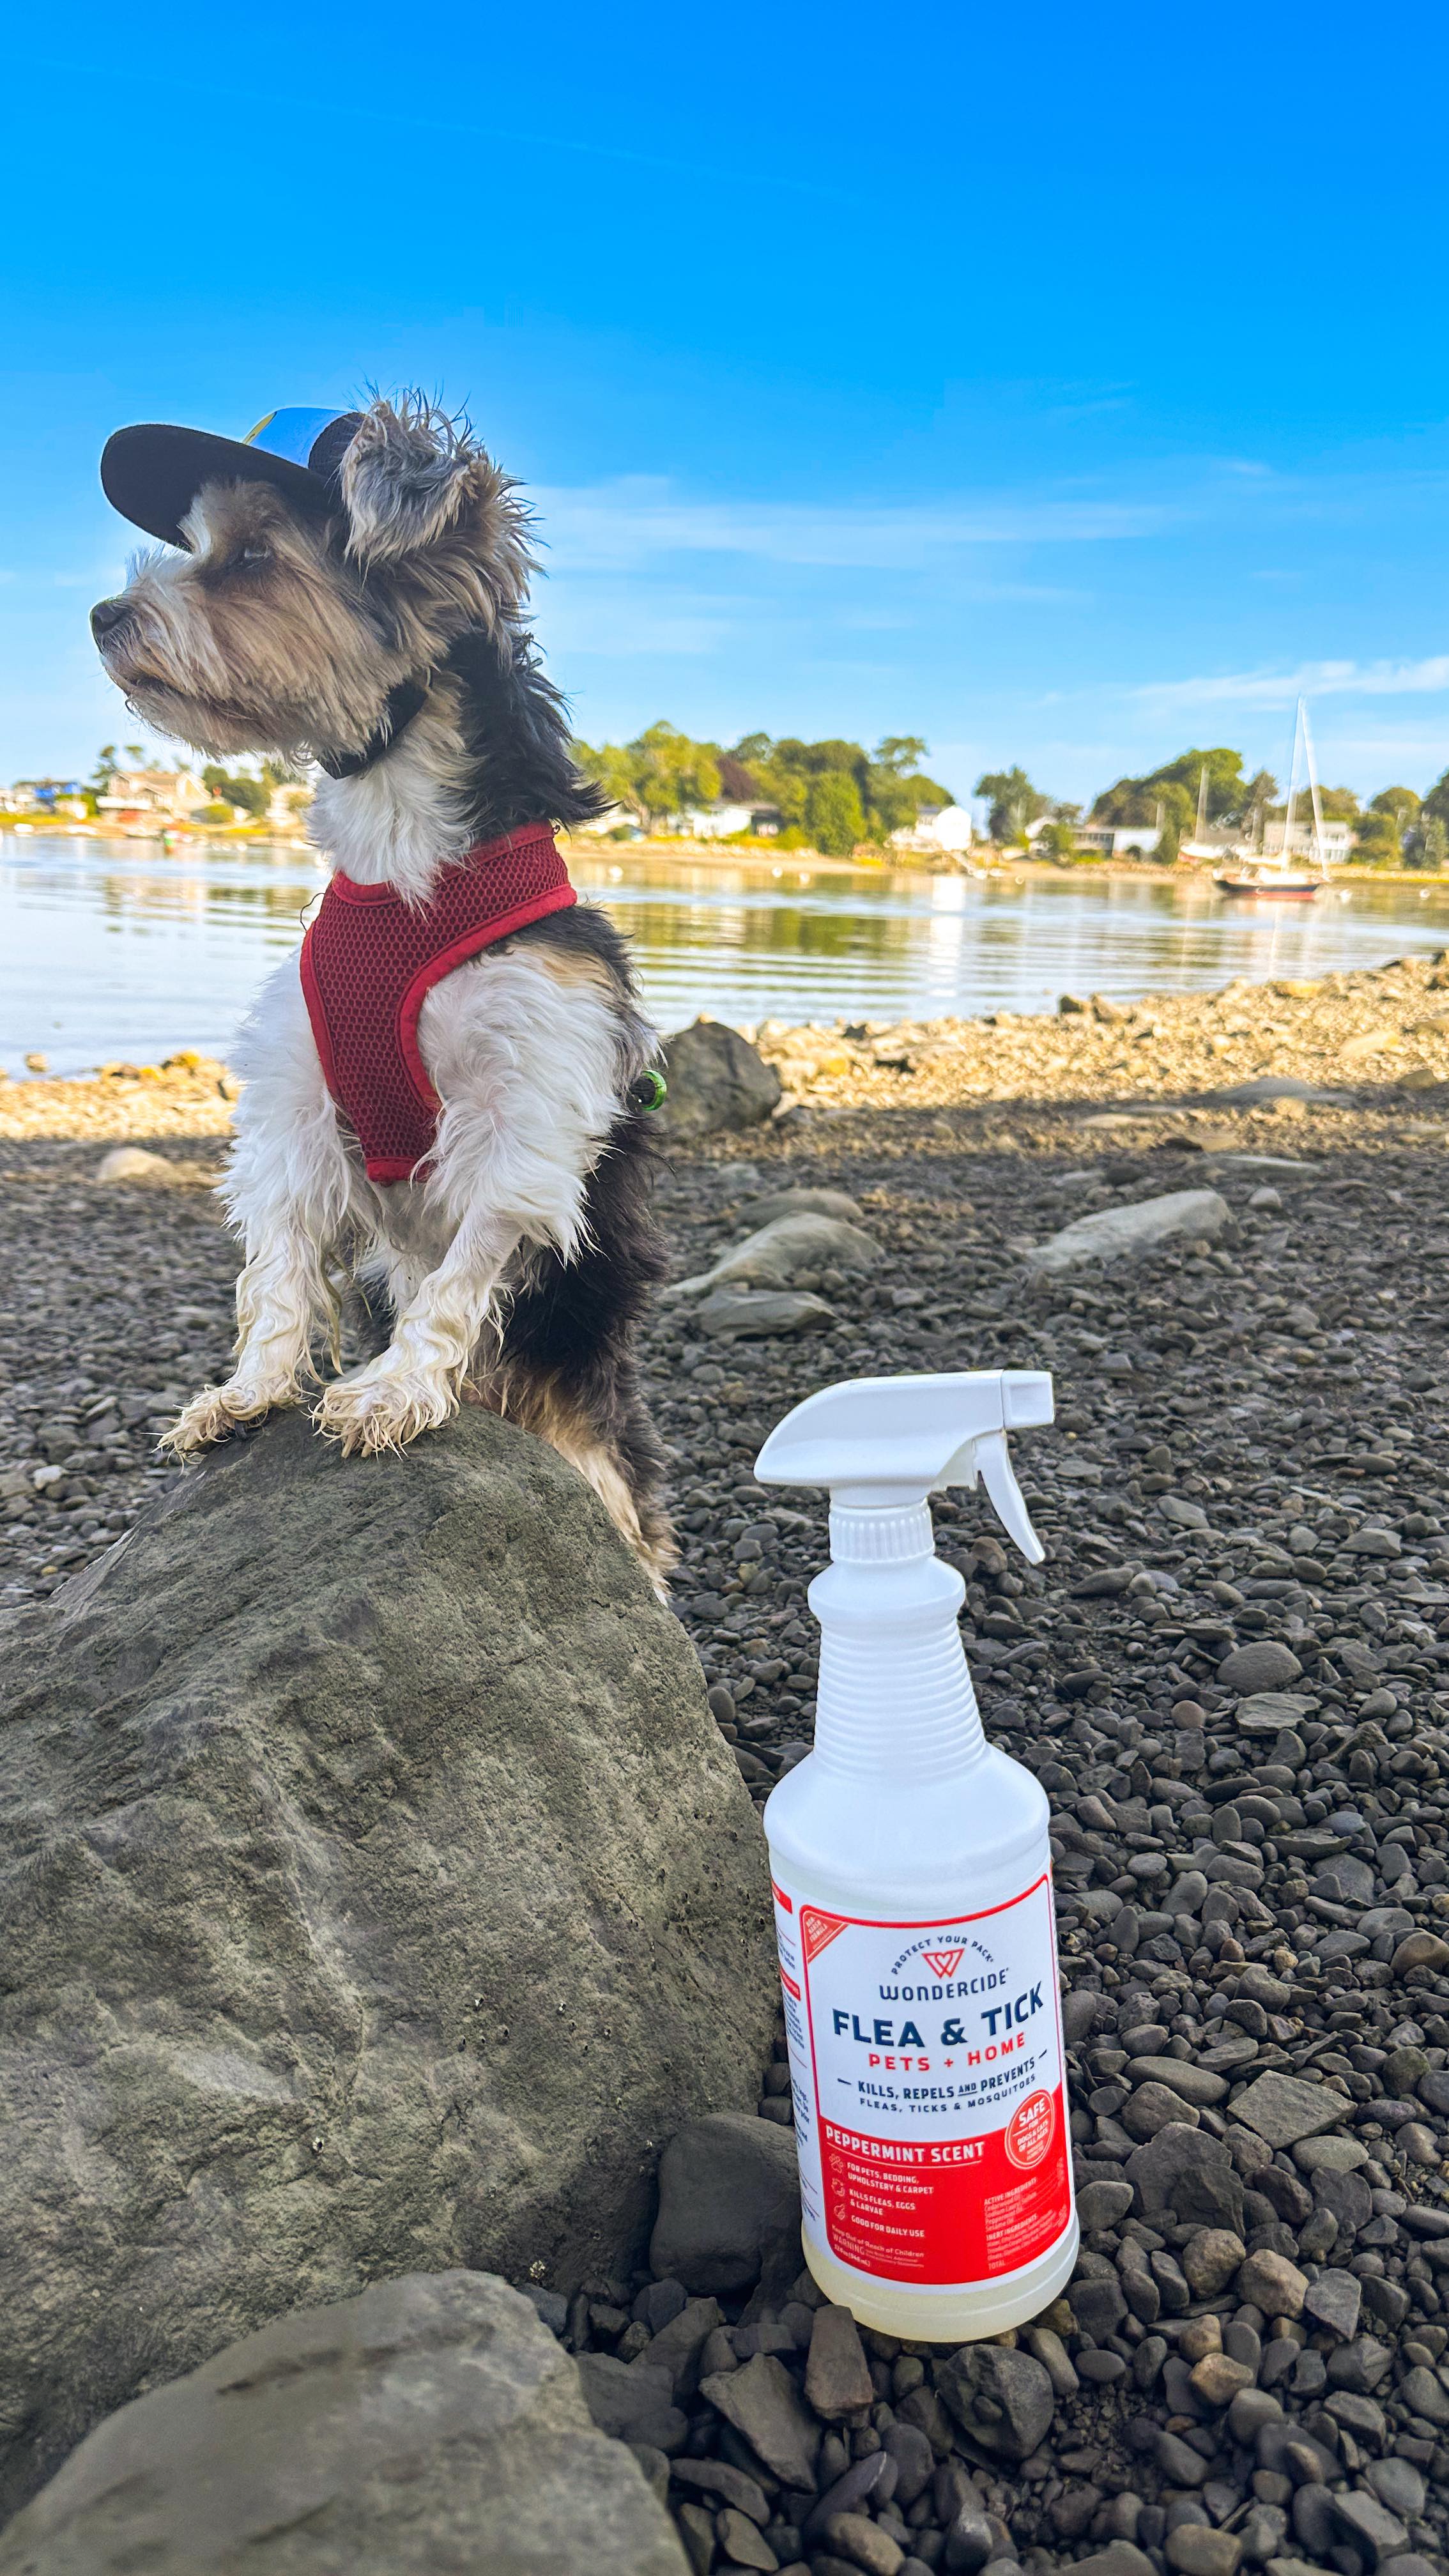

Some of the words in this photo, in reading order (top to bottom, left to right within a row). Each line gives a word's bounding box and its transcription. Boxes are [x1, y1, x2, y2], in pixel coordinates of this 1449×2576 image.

[891, 1938, 931, 1975] PROTECT
[937, 1935, 967, 1945] YOUR
[832, 2008, 925, 2048] FLEA
[940, 2018, 969, 2046] &
[981, 1981, 1044, 2037] TICK
[869, 2053, 930, 2071] PETS
[967, 2032, 1025, 2066] HOME
[858, 2080, 900, 2099] KILLS,
[903, 2085, 954, 2099] REPELS
[958, 2082, 977, 2094] AND
[981, 2057, 1035, 2092] PREVENTS
[860, 2097, 903, 2113] FLEAS,
[909, 2104, 947, 2113] TICKS
[954, 2102, 961, 2110] &
[967, 2074, 1036, 2108] MOSQUITOES
[1018, 2097, 1046, 2128] SAFE
[825, 2124, 925, 2163] PEPPERMINT
[930, 2141, 985, 2163] SCENT
[847, 2162, 861, 2172] FOR
[861, 2166, 881, 2179] PETS,
[883, 2172, 919, 2184] BEDDING,
[848, 2172, 894, 2191] UPHOLSTERY
[896, 2184, 901, 2193] &
[902, 2186, 933, 2195] CARPET
[848, 2188, 868, 2201] KILLS
[869, 2195, 894, 2209] FLEAS,
[896, 2202, 916, 2211] EGGS
[850, 2198, 855, 2207] &
[856, 2200, 884, 2216] LARVAE
[851, 2215, 870, 2228] GOOD
[870, 2222, 885, 2232] FOR
[885, 2226, 908, 2236] DAILY
[864, 2241, 885, 2251] Reach
[894, 2248, 924, 2258] Children
